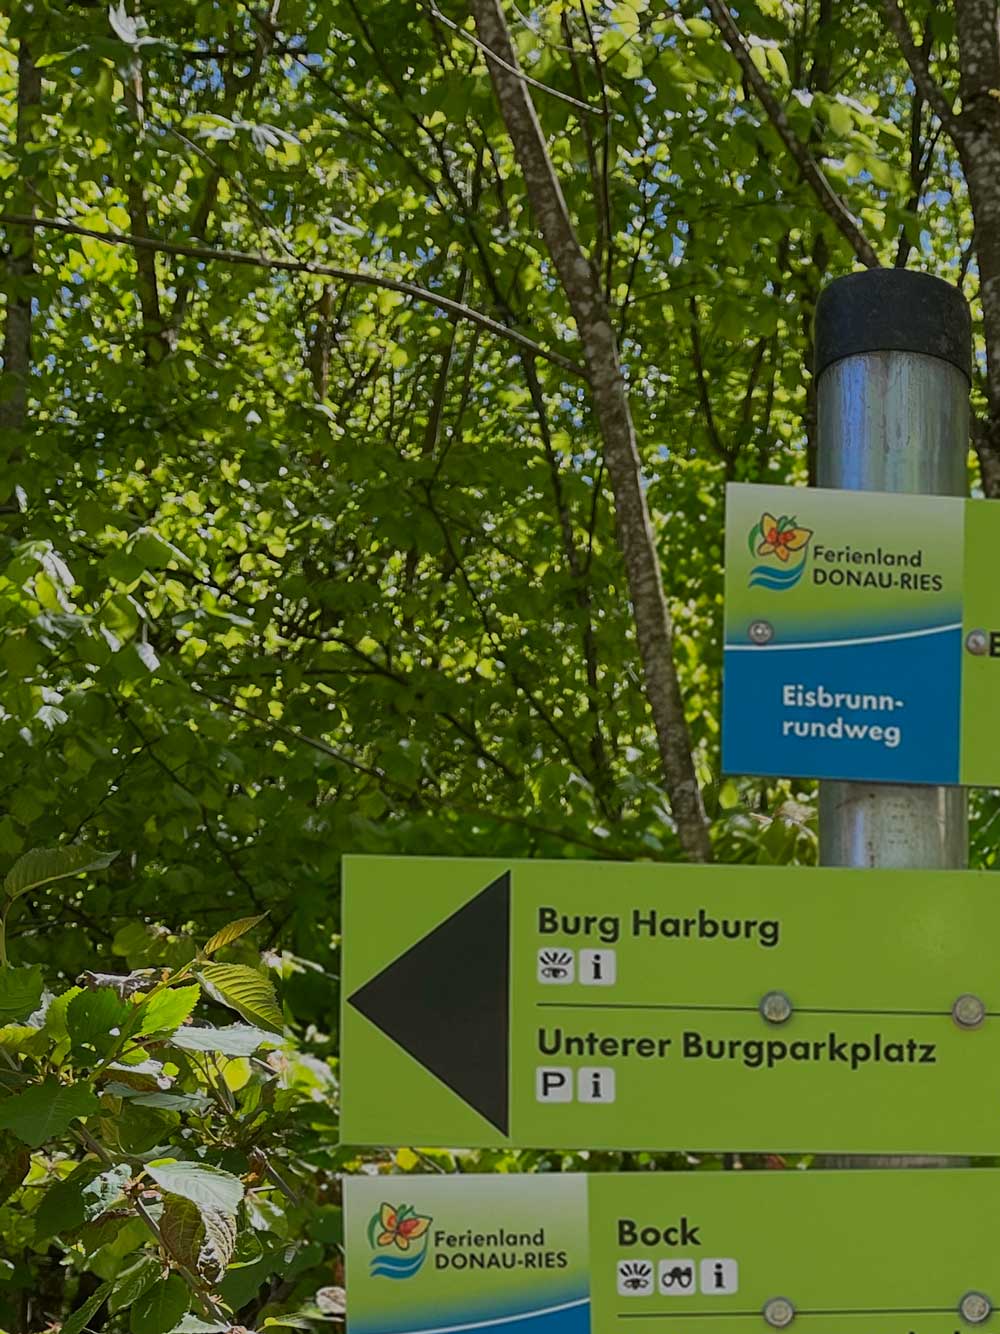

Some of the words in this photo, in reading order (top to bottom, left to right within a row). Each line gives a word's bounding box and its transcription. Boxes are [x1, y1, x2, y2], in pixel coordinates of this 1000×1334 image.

[813, 545, 922, 571] Ferienland
[813, 567, 943, 592] DONAU-RIES
[783, 684, 904, 711] Eisbrunn-
[782, 716, 901, 748] rundweg
[538, 907, 620, 944] Burg
[632, 908, 779, 948] Harburg
[538, 1027, 672, 1058] Unterer
[683, 1031, 937, 1071] Burgparkplatz
[434, 1227, 545, 1248] Ferienland
[617, 1217, 702, 1247] Bock
[434, 1251, 568, 1270] DONAU-RIES
